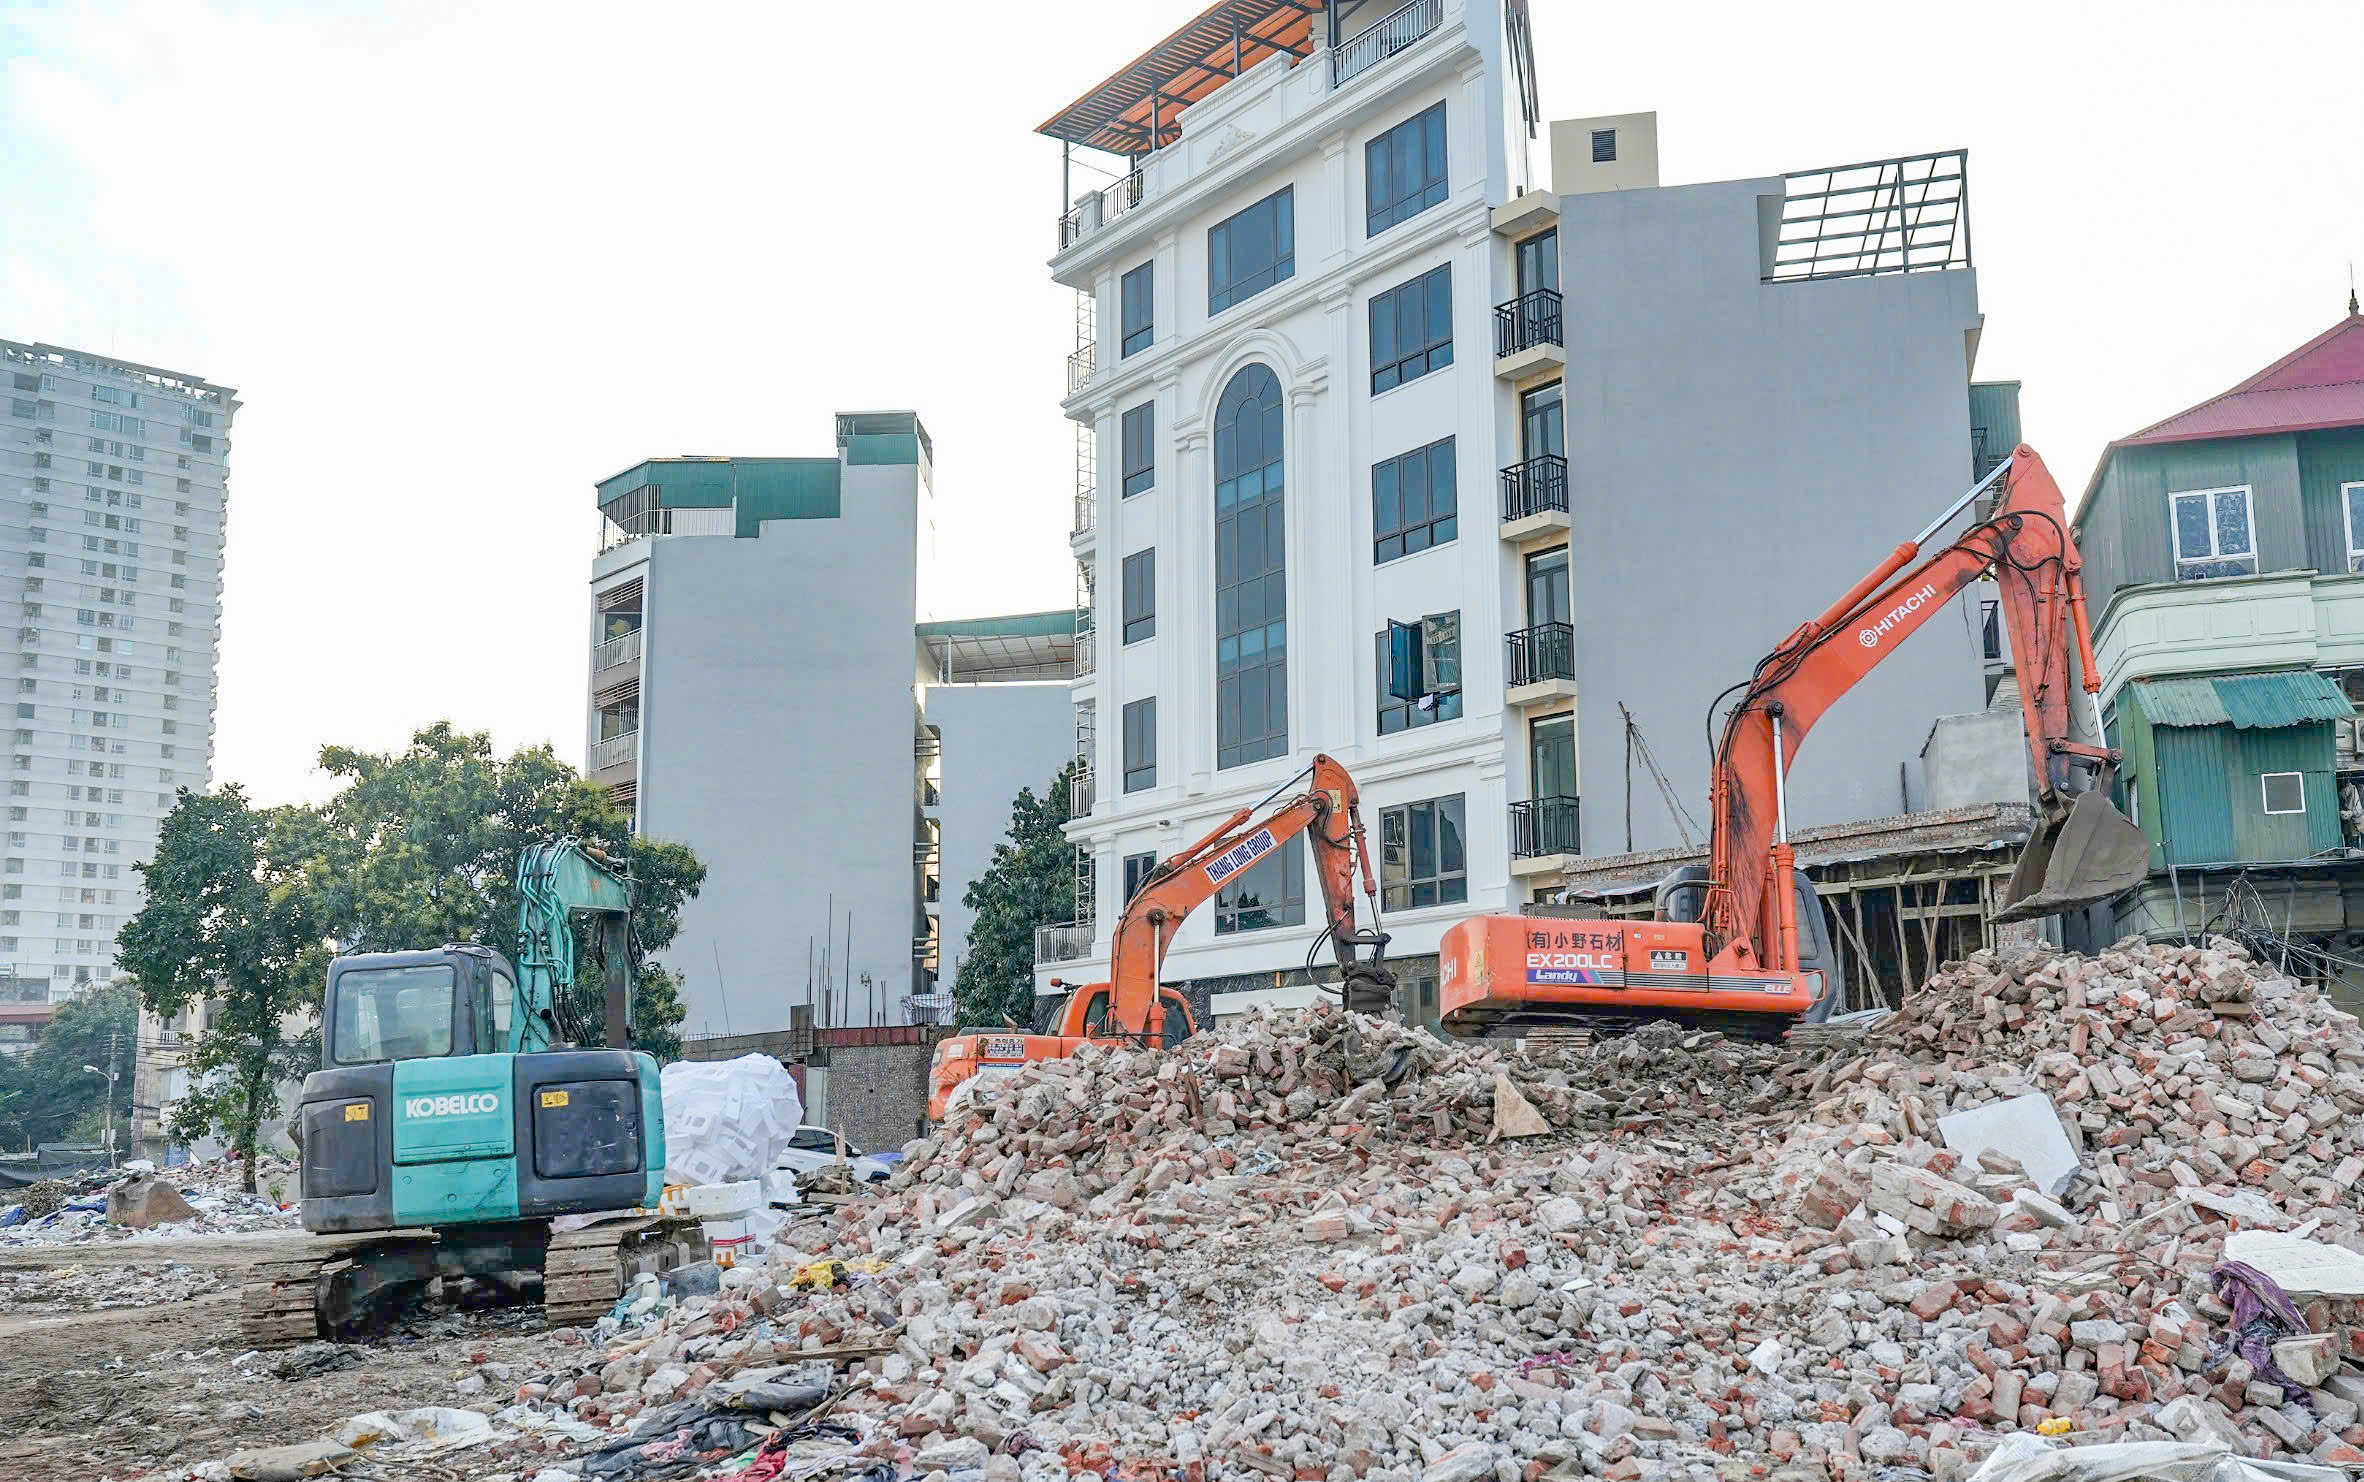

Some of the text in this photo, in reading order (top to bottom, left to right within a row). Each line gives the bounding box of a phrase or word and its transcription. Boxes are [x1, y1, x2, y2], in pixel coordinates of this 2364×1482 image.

[1873, 584, 1936, 636] HITACHI
[1206, 830, 1273, 882] THANG LONG GROUP
[1526, 953, 1613, 969] EX200LC
[1535, 969, 1578, 983] Landy
[1764, 984, 1791, 994] ELLE
[406, 1093, 498, 1119] KOBELCO
